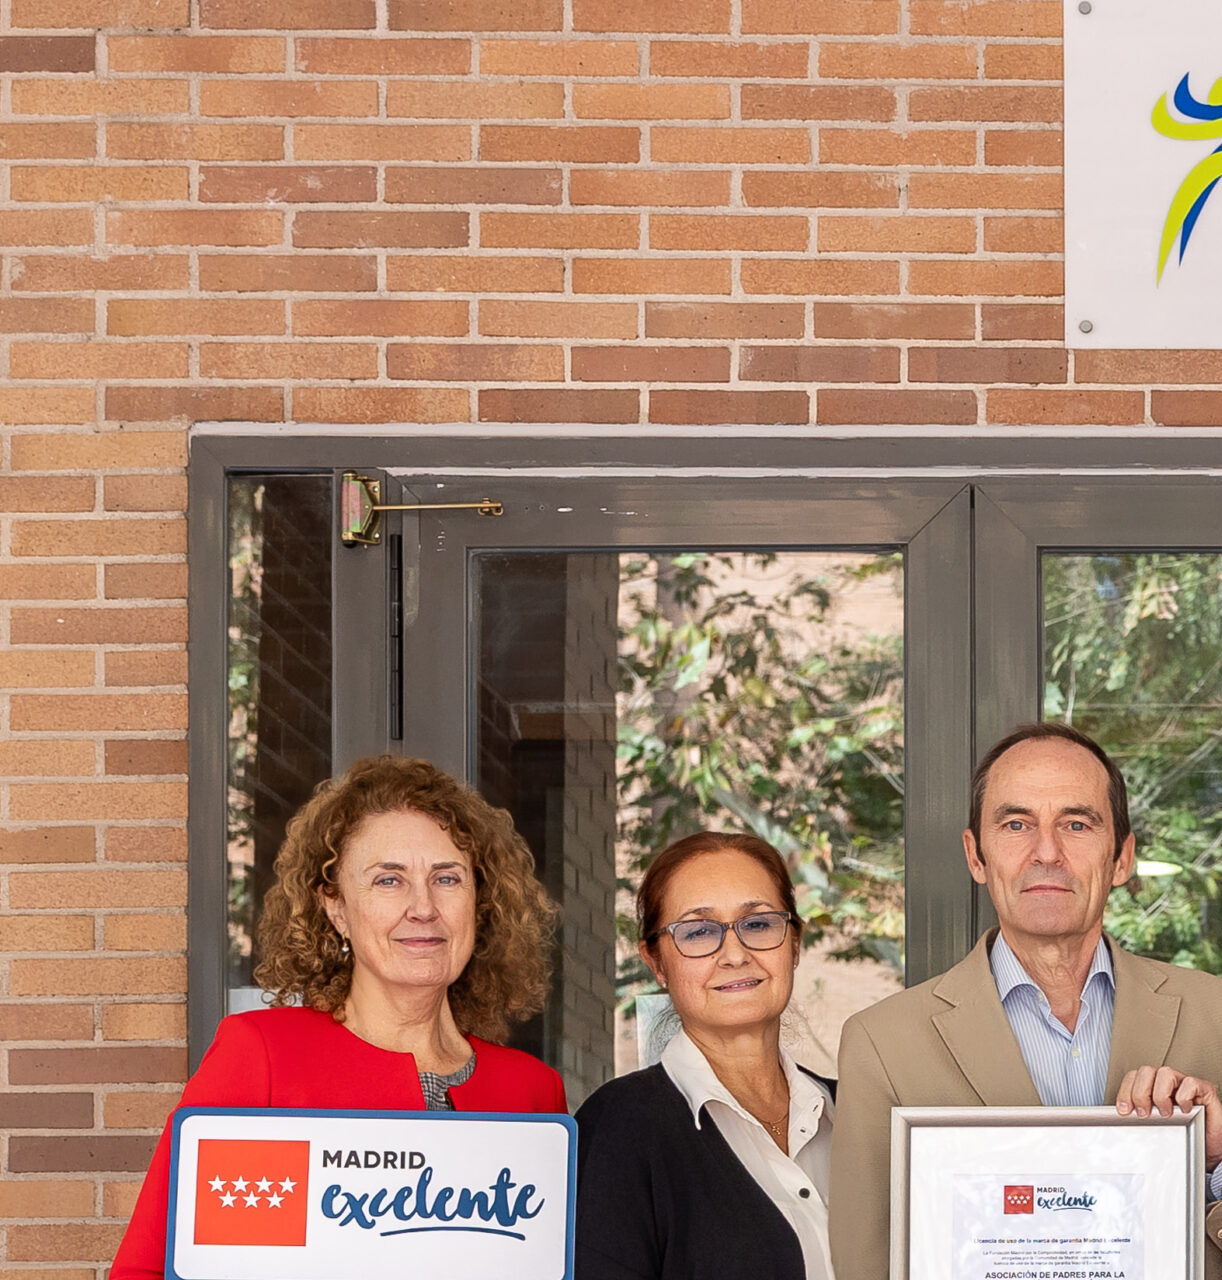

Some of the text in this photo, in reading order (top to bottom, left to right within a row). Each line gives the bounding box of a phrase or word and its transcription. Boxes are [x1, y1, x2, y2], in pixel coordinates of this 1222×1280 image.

[322, 1150, 426, 1169] MADRID
[321, 1167, 545, 1229] excelente
[1037, 1191, 1097, 1209] excelente
[985, 1270, 1037, 1279] ASOCIACIÓN
[1039, 1271, 1051, 1279] DE
[1053, 1271, 1087, 1279] PADRES
[1088, 1271, 1112, 1279] PARA
